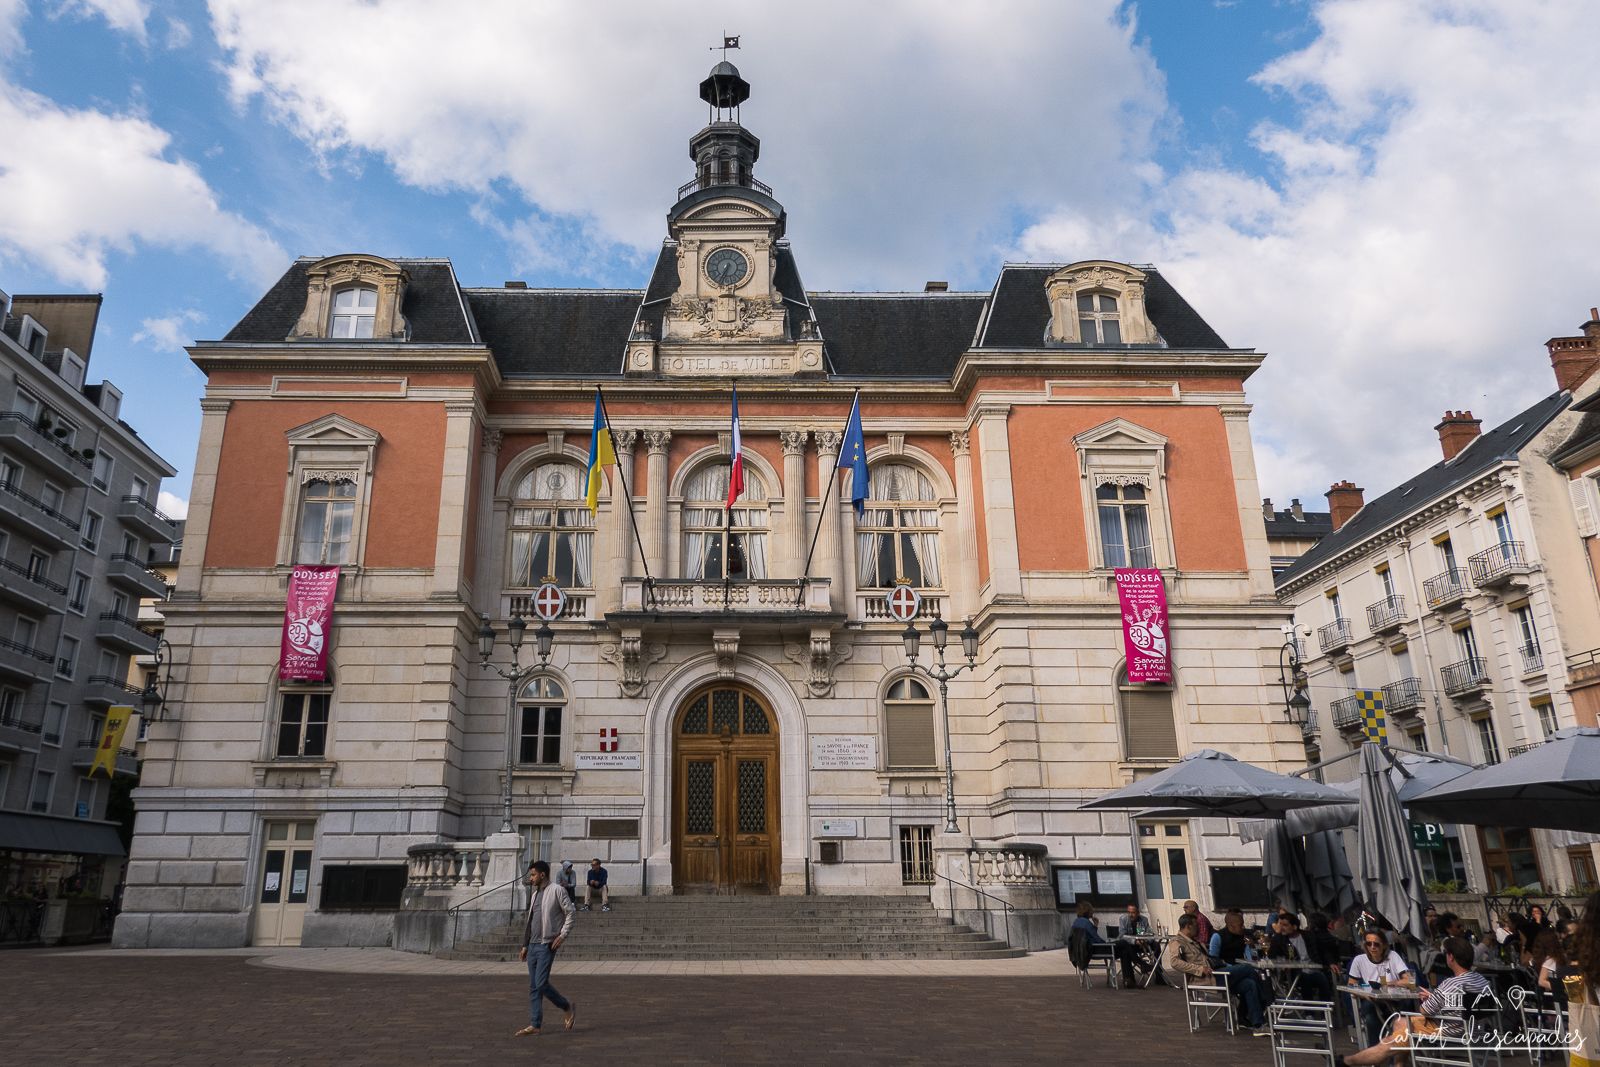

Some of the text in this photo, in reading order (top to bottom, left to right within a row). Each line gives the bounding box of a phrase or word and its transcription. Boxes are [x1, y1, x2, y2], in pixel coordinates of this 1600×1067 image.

[721, 360, 738, 370] DE
[744, 358, 790, 370] VILLE
[293, 569, 337, 580] ODYSSEA
[1116, 570, 1161, 583] ODYSSEA
[289, 624, 301, 635] 20
[1130, 628, 1142, 638] 20
[293, 632, 306, 643] 23
[1137, 635, 1149, 646] 23
[285, 653, 319, 662] Samedi
[299, 661, 317, 669] Mai
[1134, 663, 1147, 671] 27
[1425, 824, 1436, 841] P
